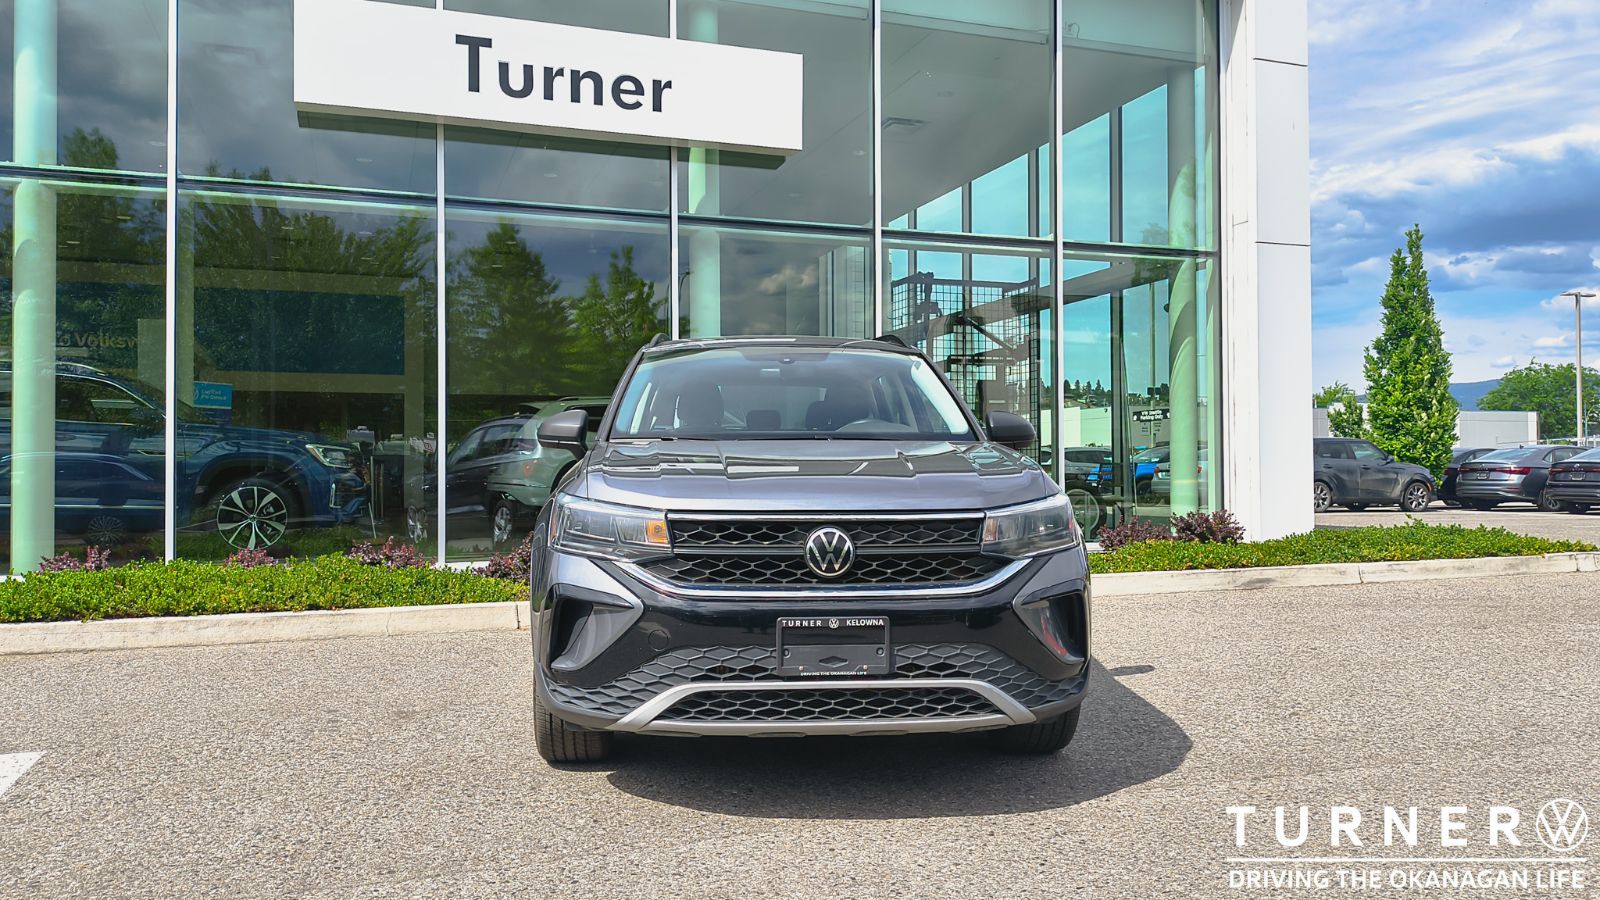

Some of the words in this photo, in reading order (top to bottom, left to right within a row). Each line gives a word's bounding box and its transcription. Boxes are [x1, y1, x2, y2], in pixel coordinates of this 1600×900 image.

[454, 33, 673, 113] Turner
[808, 529, 851, 572] VW
[782, 619, 822, 627] TURNER
